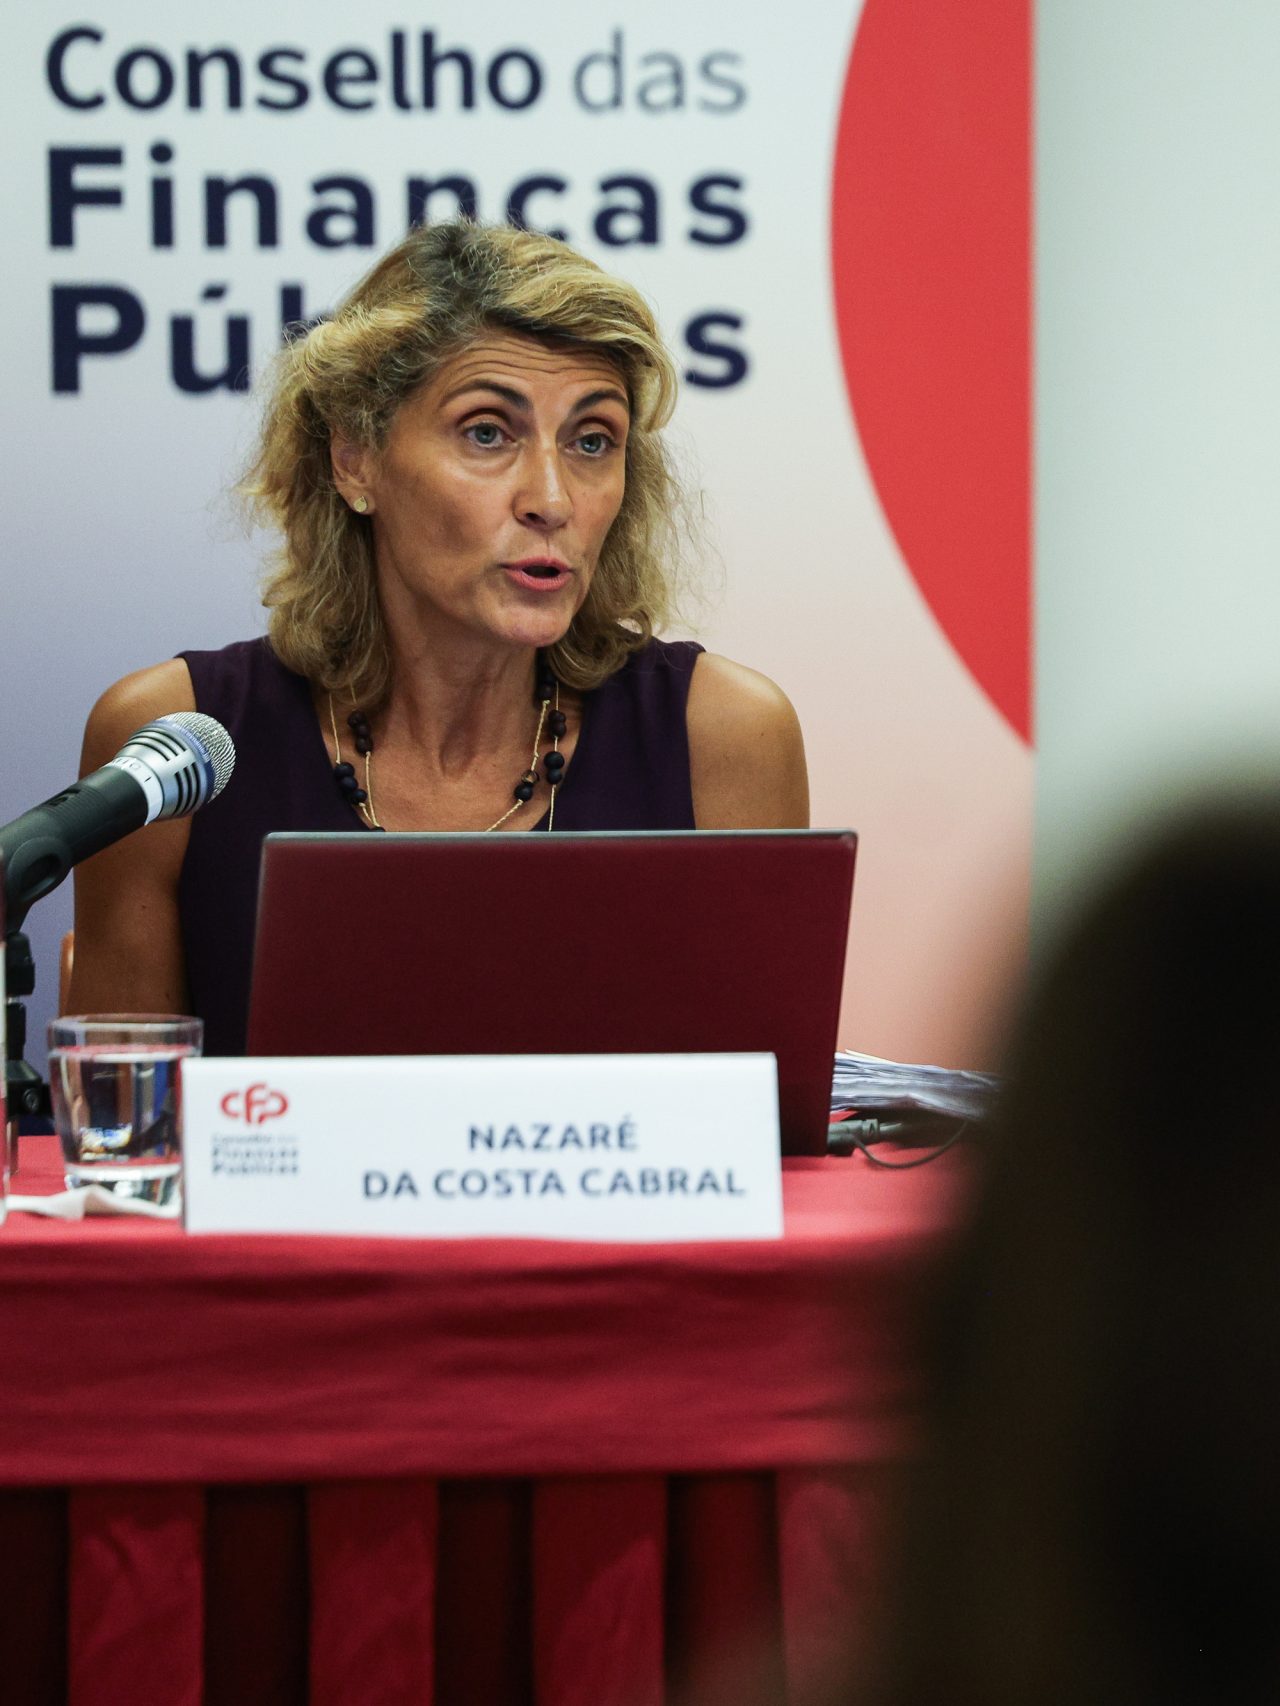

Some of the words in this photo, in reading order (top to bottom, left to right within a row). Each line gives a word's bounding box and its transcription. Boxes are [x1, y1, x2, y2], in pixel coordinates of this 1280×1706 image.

[45, 25, 544, 113] Conselho
[571, 26, 747, 114] das
[467, 1115, 640, 1152] NAZARÉ
[362, 1171, 419, 1200] DA
[432, 1170, 566, 1199] COSTA
[580, 1168, 747, 1197] CABRAL
